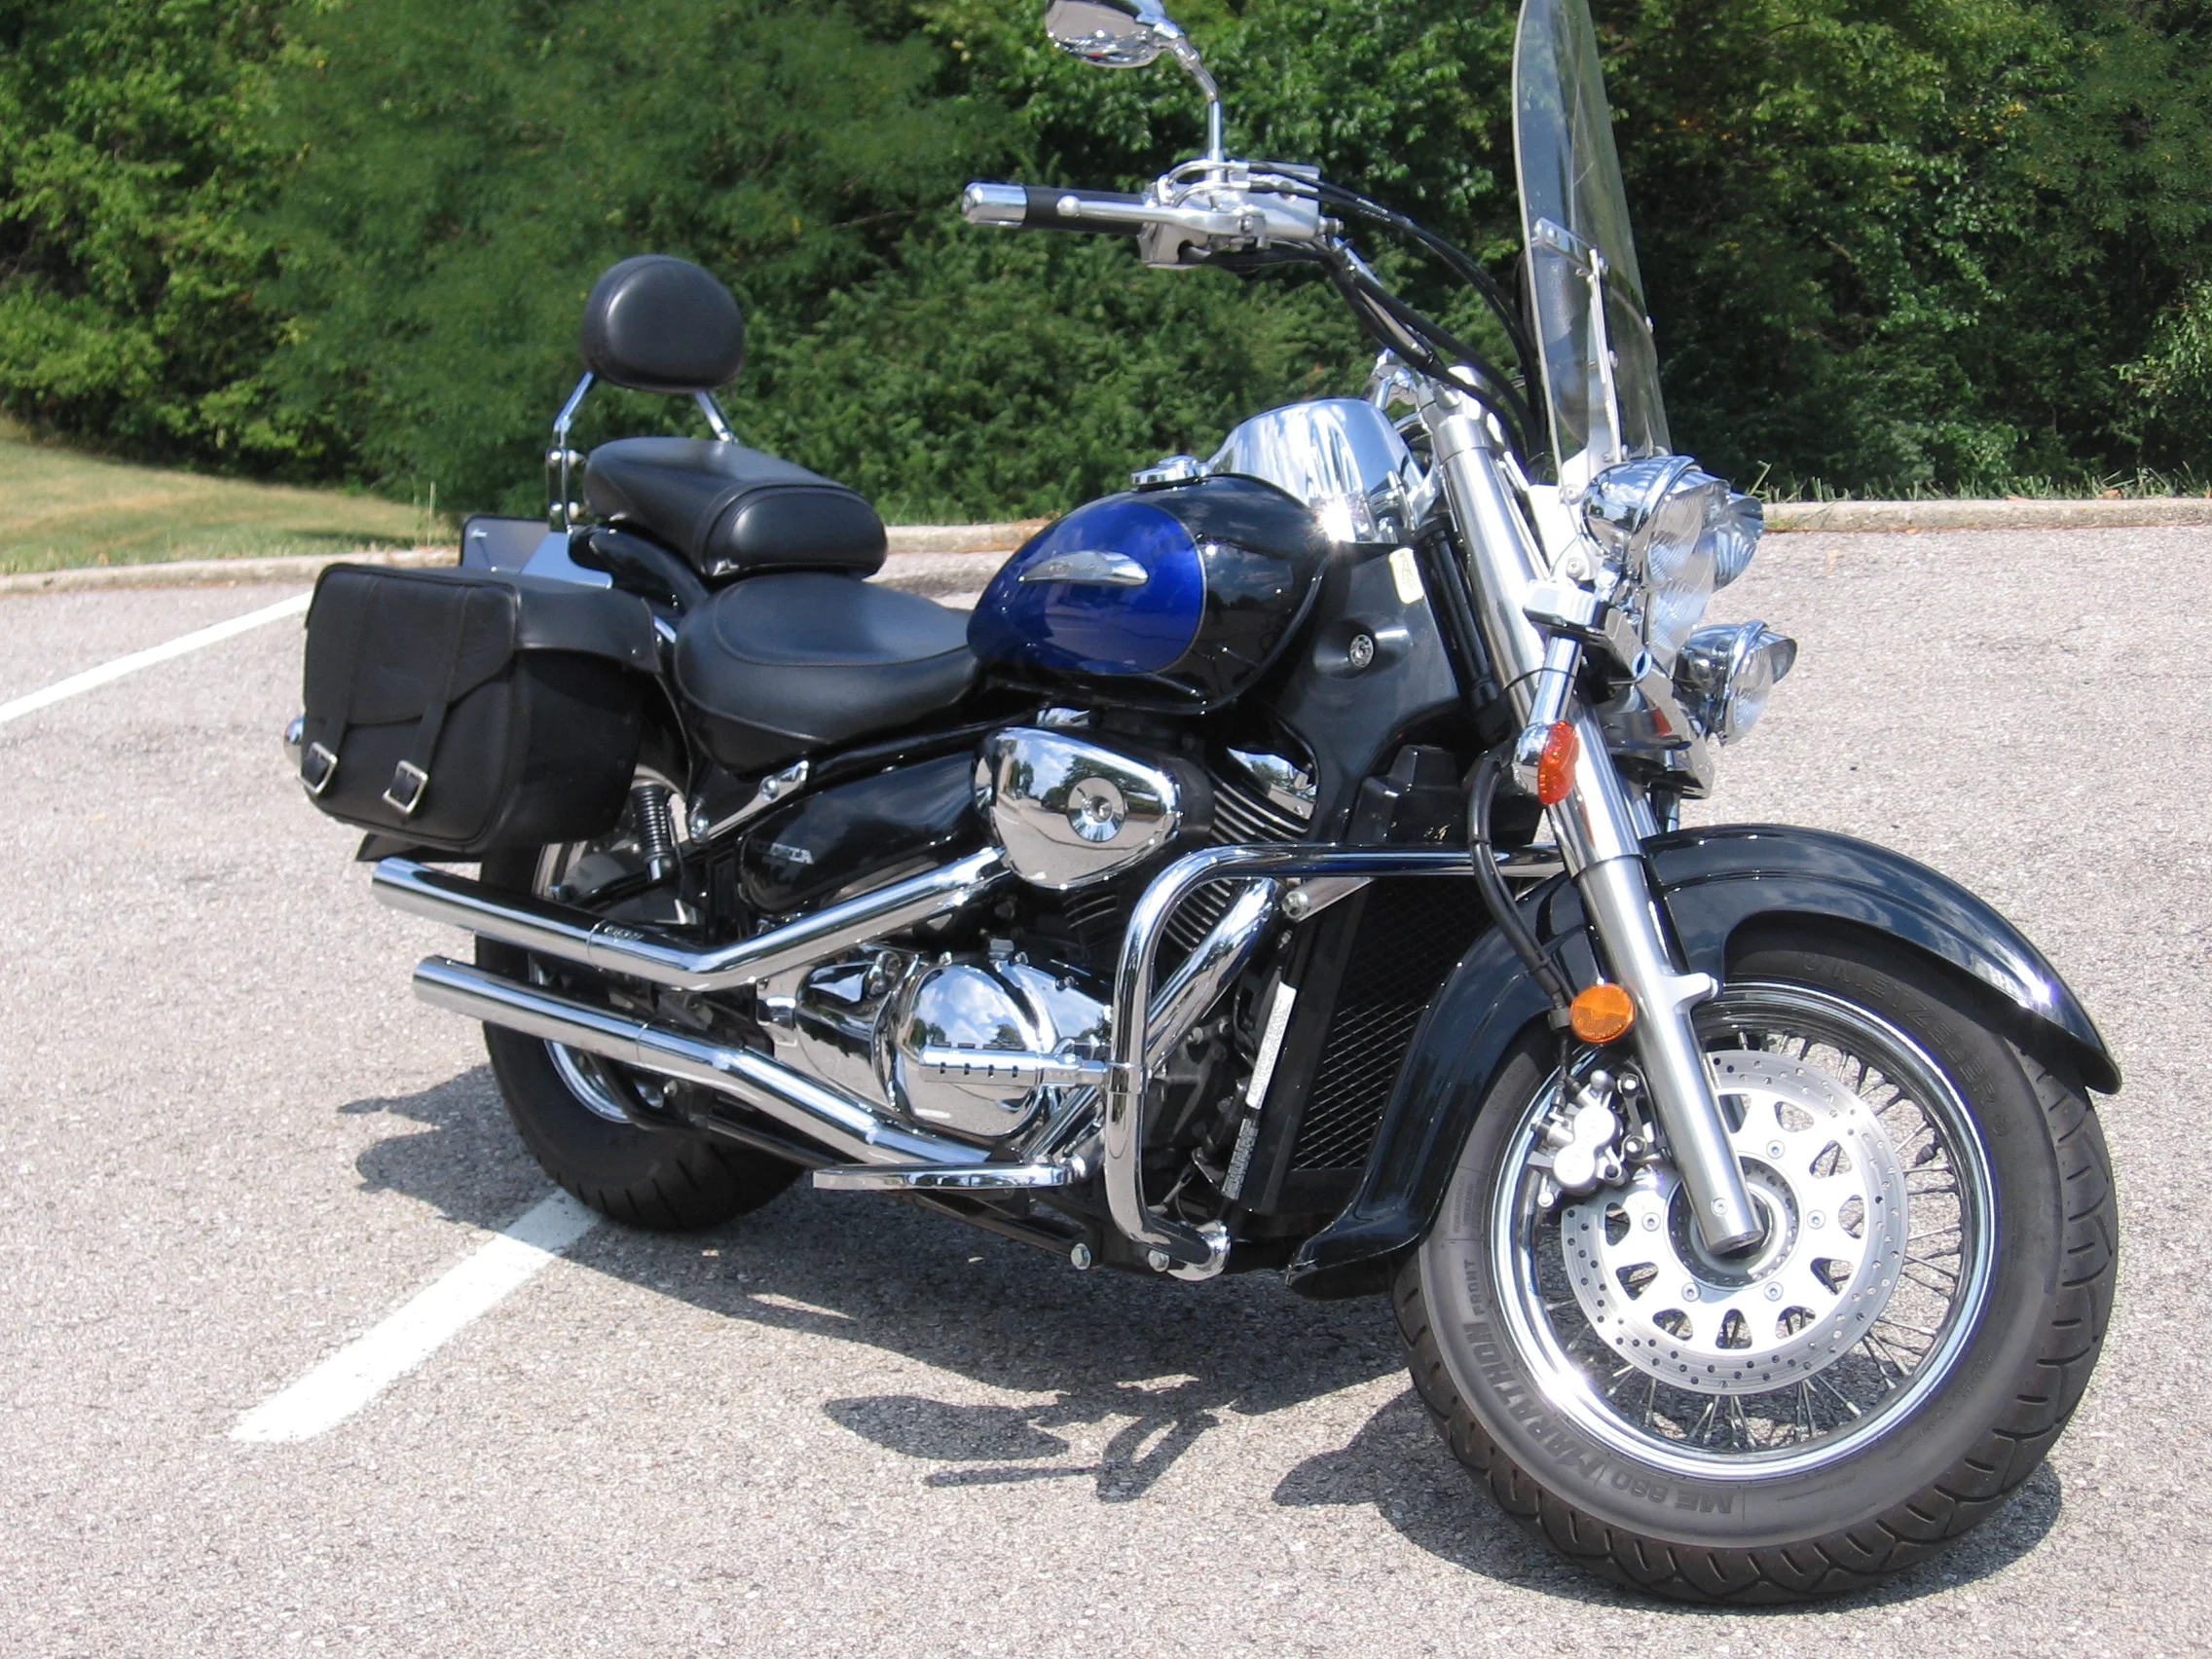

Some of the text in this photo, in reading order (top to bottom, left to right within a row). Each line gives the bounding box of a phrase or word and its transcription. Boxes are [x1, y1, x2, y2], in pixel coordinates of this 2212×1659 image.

[1830, 961, 1999, 1110] METZELER
[1463, 1259, 1486, 1316] FRONT
[1462, 1320, 1734, 1515] ME 880 MARATHON
